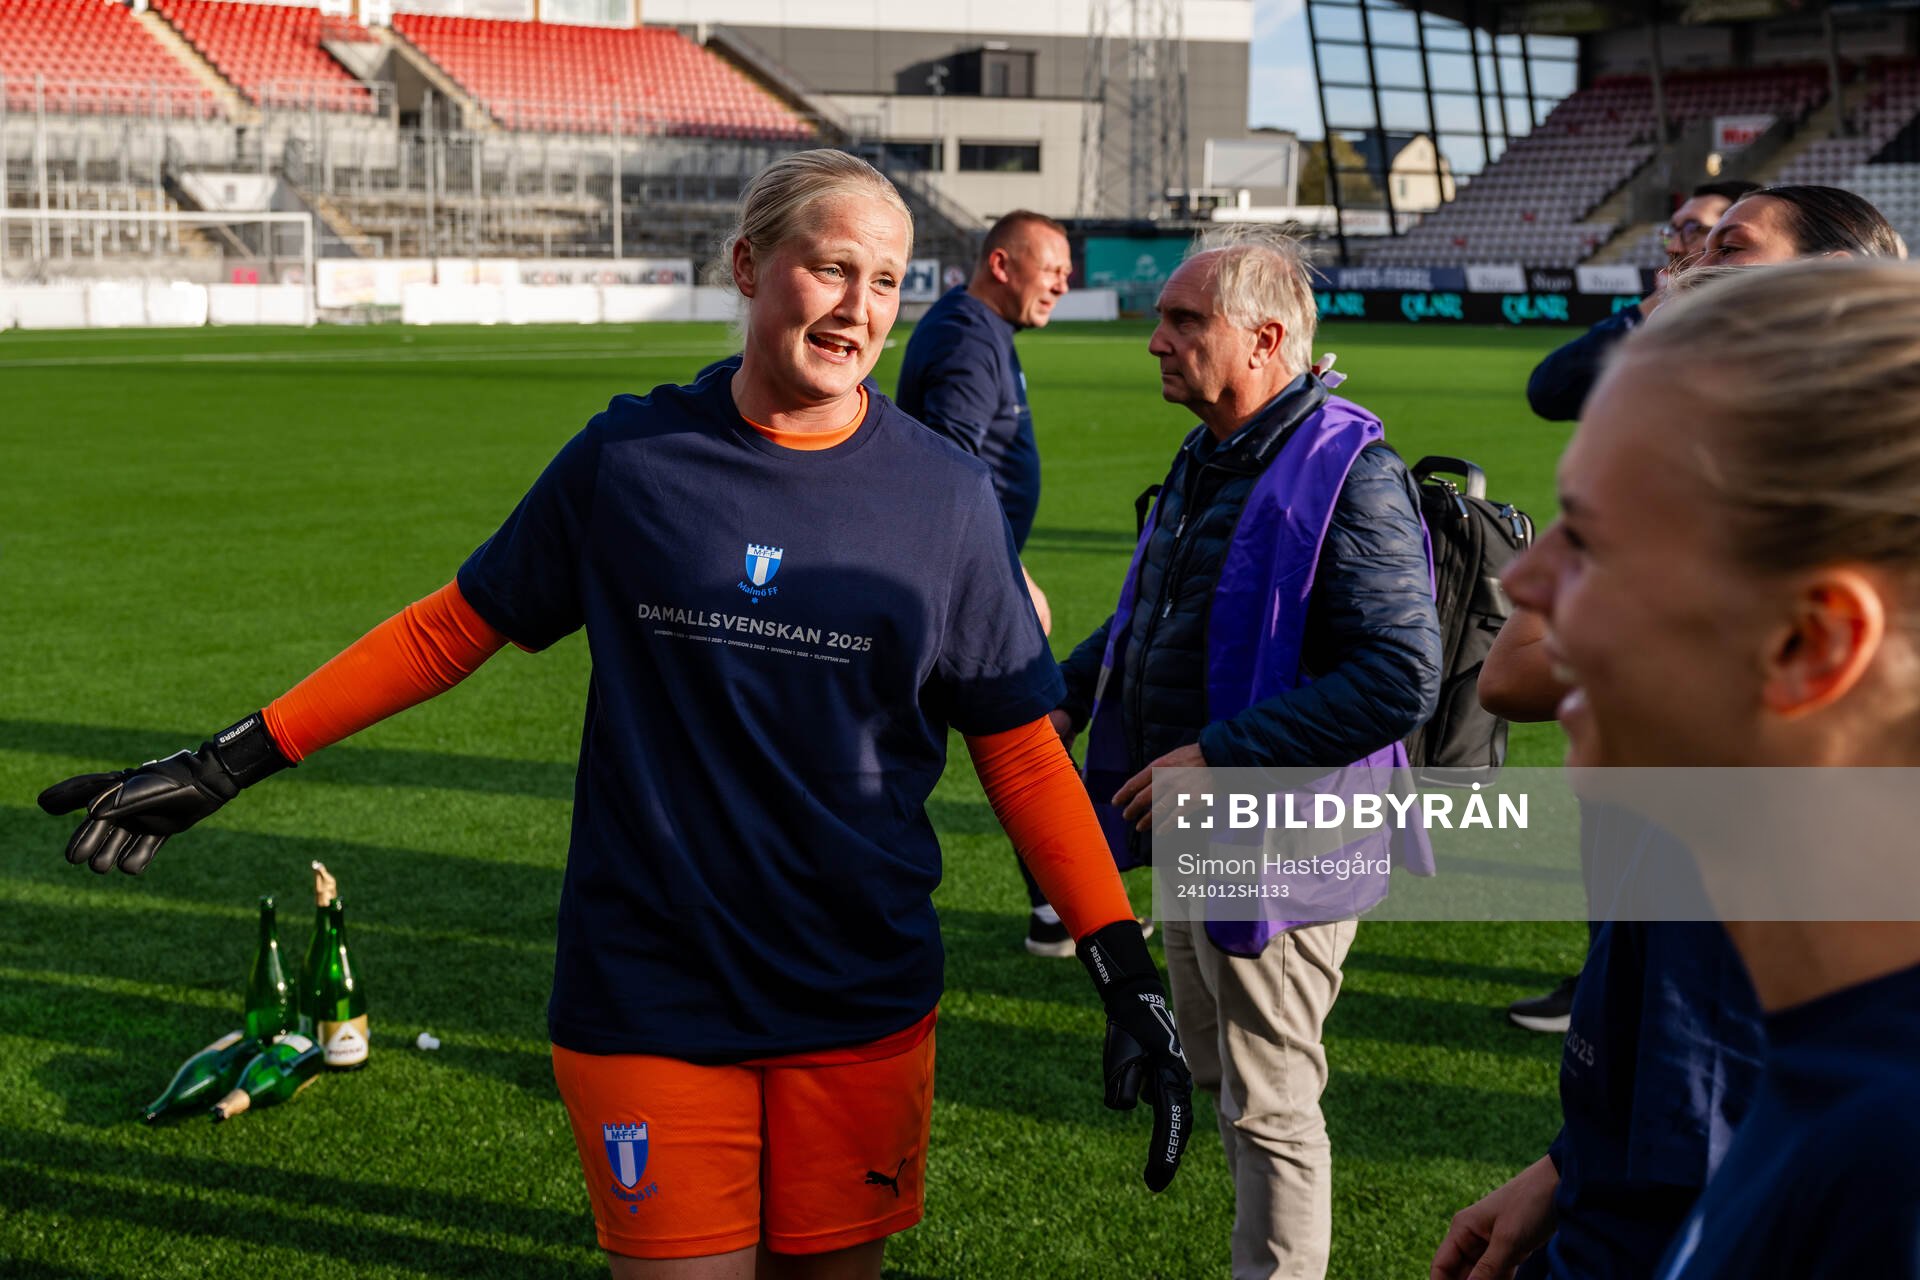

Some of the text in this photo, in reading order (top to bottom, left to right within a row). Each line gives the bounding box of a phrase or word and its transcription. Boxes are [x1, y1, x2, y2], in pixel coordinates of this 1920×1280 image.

[737, 581, 779, 597] Malmö FF
[637, 604, 873, 652] DAMALLSVENSKAN 2025
[219, 718, 255, 744] KEEPERS
[1090, 945, 1111, 985] KEEPERS
[1166, 1105, 1181, 1164] KEEPERS
